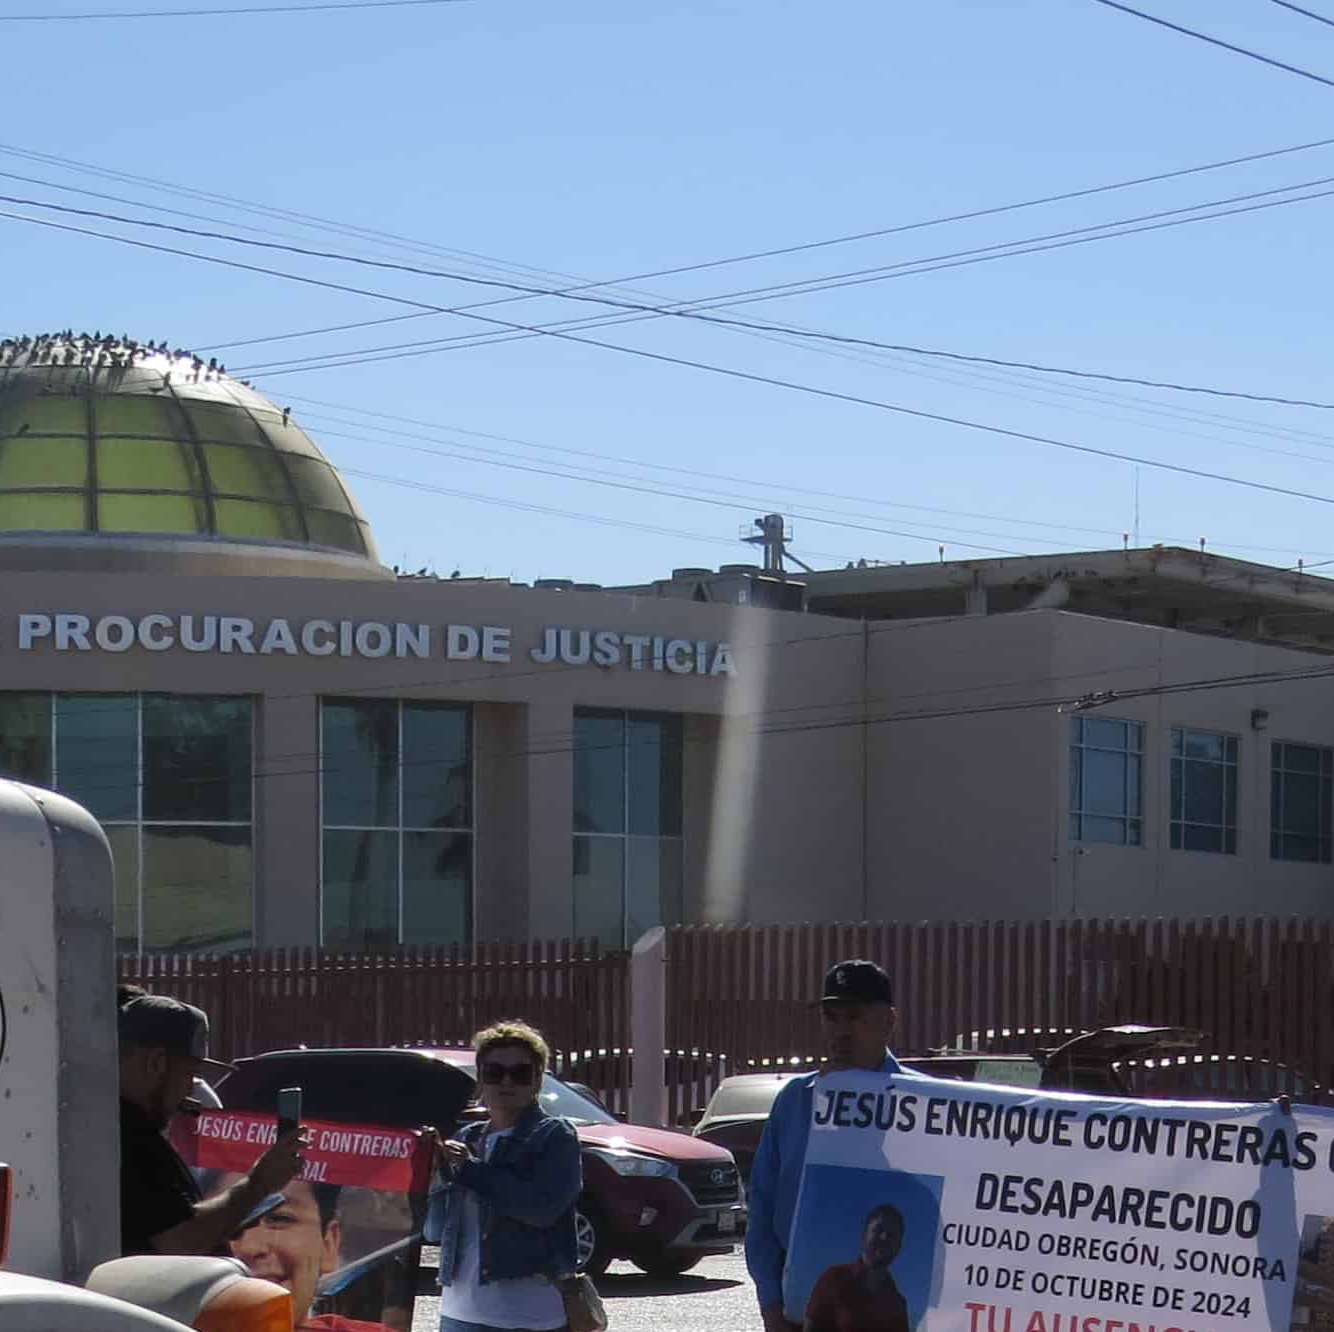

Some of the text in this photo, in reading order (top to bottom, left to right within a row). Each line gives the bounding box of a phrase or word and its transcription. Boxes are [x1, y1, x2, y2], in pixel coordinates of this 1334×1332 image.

[18, 613, 430, 660] PROCURACION
[447, 624, 511, 664] DE
[530, 628, 738, 678] JUSTICIA
[192, 1114, 243, 1142] JESÚS
[319, 1129, 412, 1159] CONTRERAS
[815, 1085, 917, 1133] JESÚS
[924, 1097, 1077, 1147] ENRIQUE
[1083, 1113, 1317, 1171] CONTRERAS
[975, 1172, 1262, 1239] DESAPARECIDO
[942, 1223, 1287, 1282] CIUDAD OBREGÓN, SONORA
[965, 1264, 1252, 1318] 10 DE OCTUBRE DE 2024
